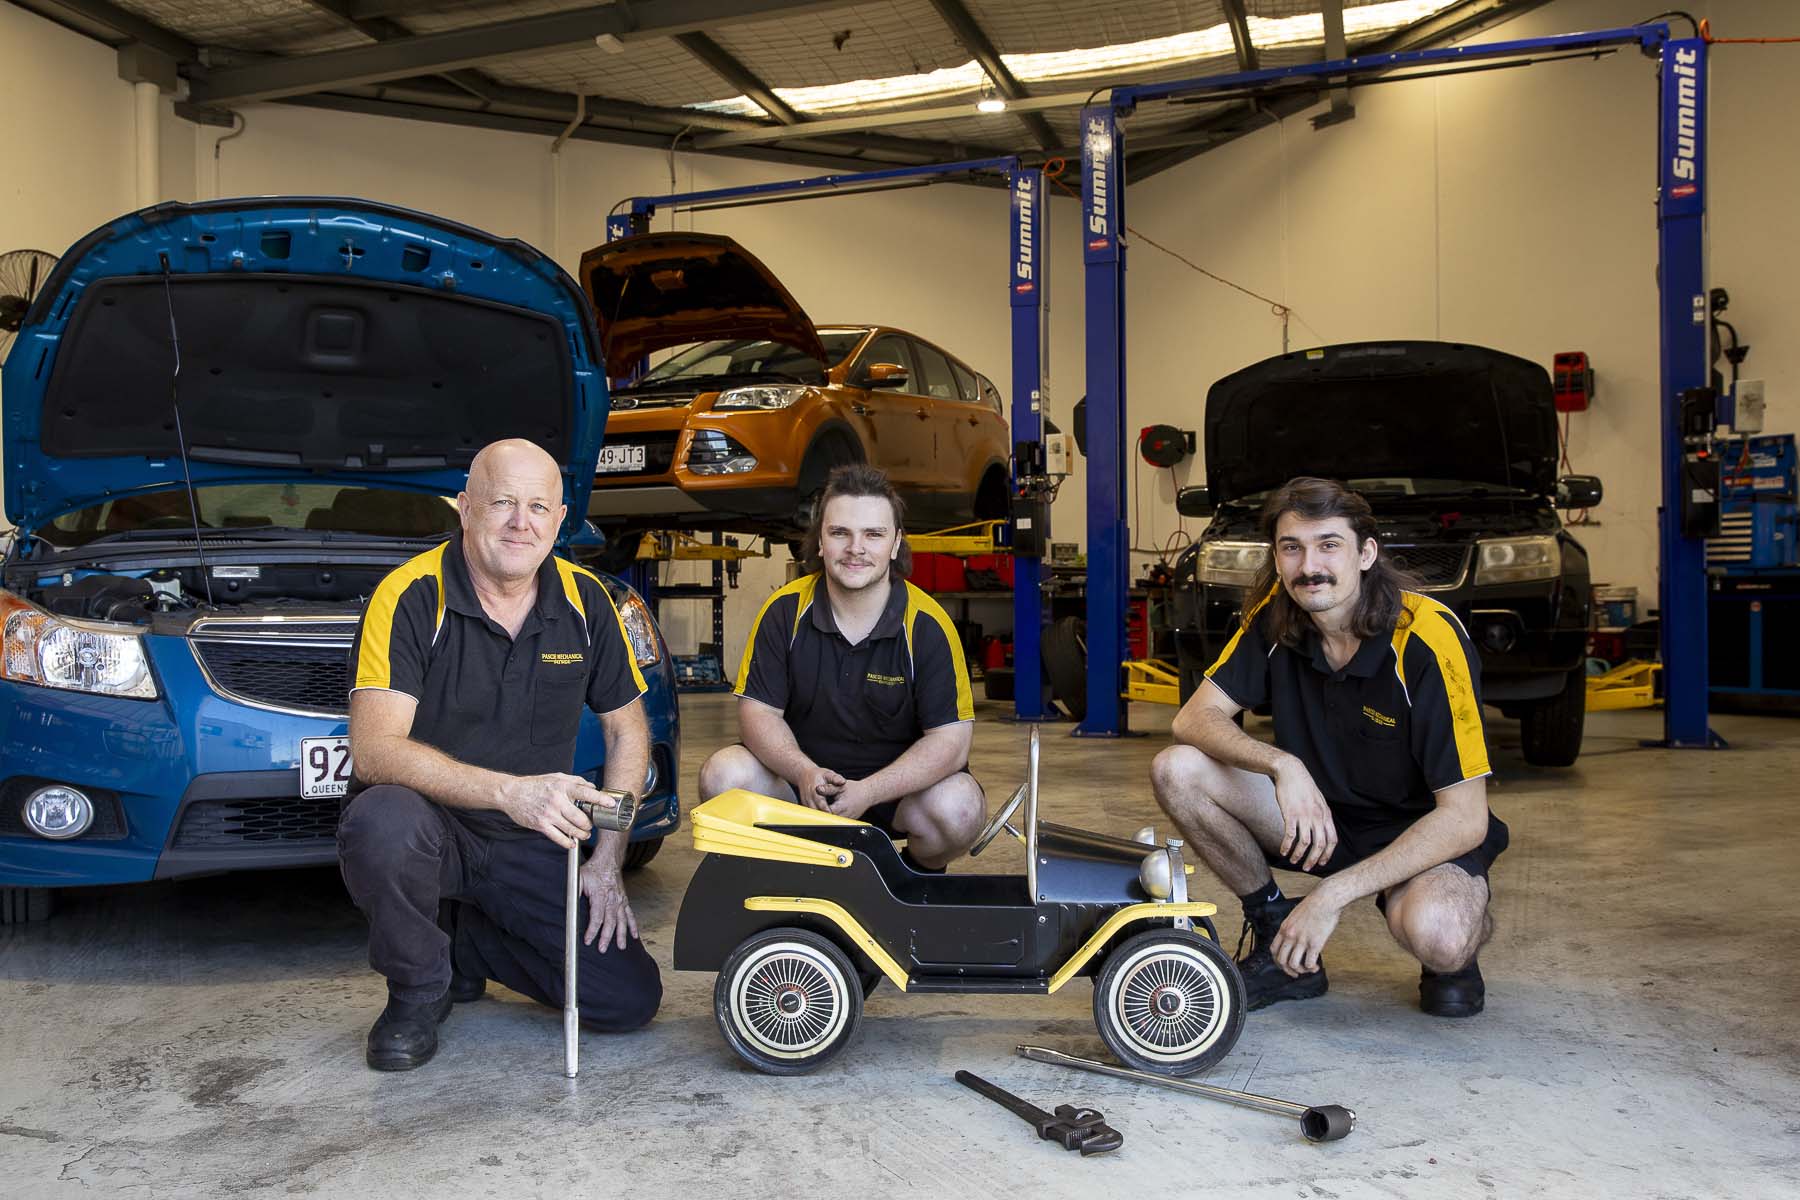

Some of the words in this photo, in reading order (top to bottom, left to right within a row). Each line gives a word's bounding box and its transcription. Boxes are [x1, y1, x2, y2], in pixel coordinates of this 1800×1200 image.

[1673, 48, 1697, 180] Summit
[1016, 177, 1032, 280] Summit
[309, 744, 352, 782] 92
